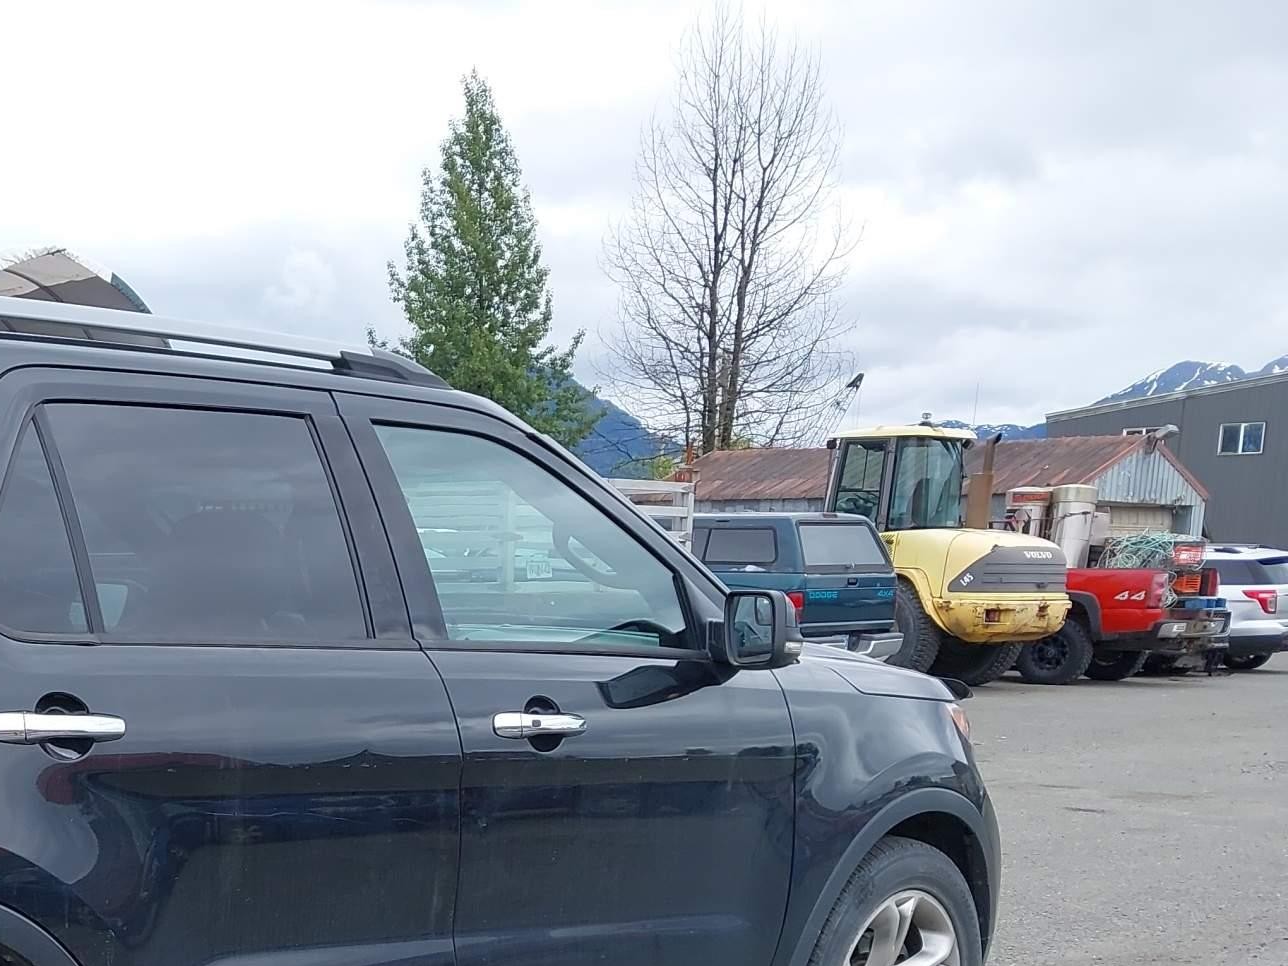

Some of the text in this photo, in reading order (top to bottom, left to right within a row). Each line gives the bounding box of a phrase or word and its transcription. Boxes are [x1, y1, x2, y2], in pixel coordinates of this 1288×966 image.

[1024, 551, 1053, 559] VOLVO
[959, 572, 975, 587] L45
[809, 591, 838, 599] DODGE
